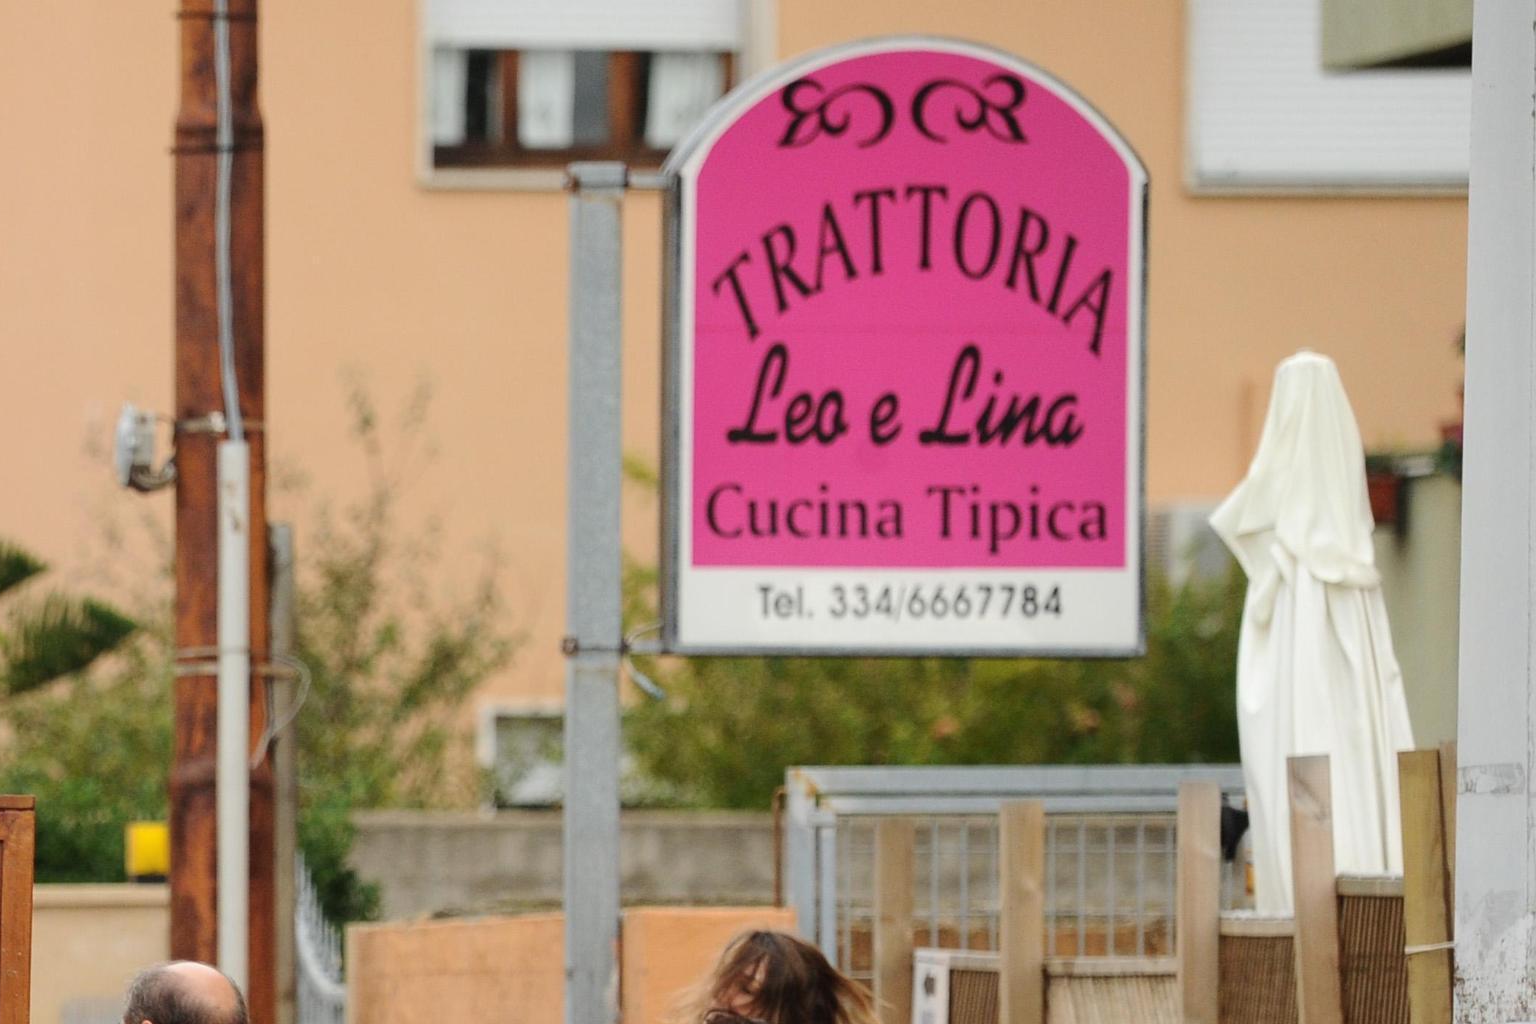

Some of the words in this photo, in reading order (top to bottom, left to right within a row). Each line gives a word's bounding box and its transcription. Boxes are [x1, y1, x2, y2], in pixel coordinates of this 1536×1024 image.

[711, 184, 1114, 358] TRATTORIA
[726, 343, 849, 447] Leo
[869, 392, 903, 447] e
[918, 344, 1084, 448] Lina
[705, 483, 905, 540] Cucina
[925, 483, 1108, 556] Tipica
[756, 584, 814, 620] Tel.
[828, 582, 1064, 623] 334/6667784
